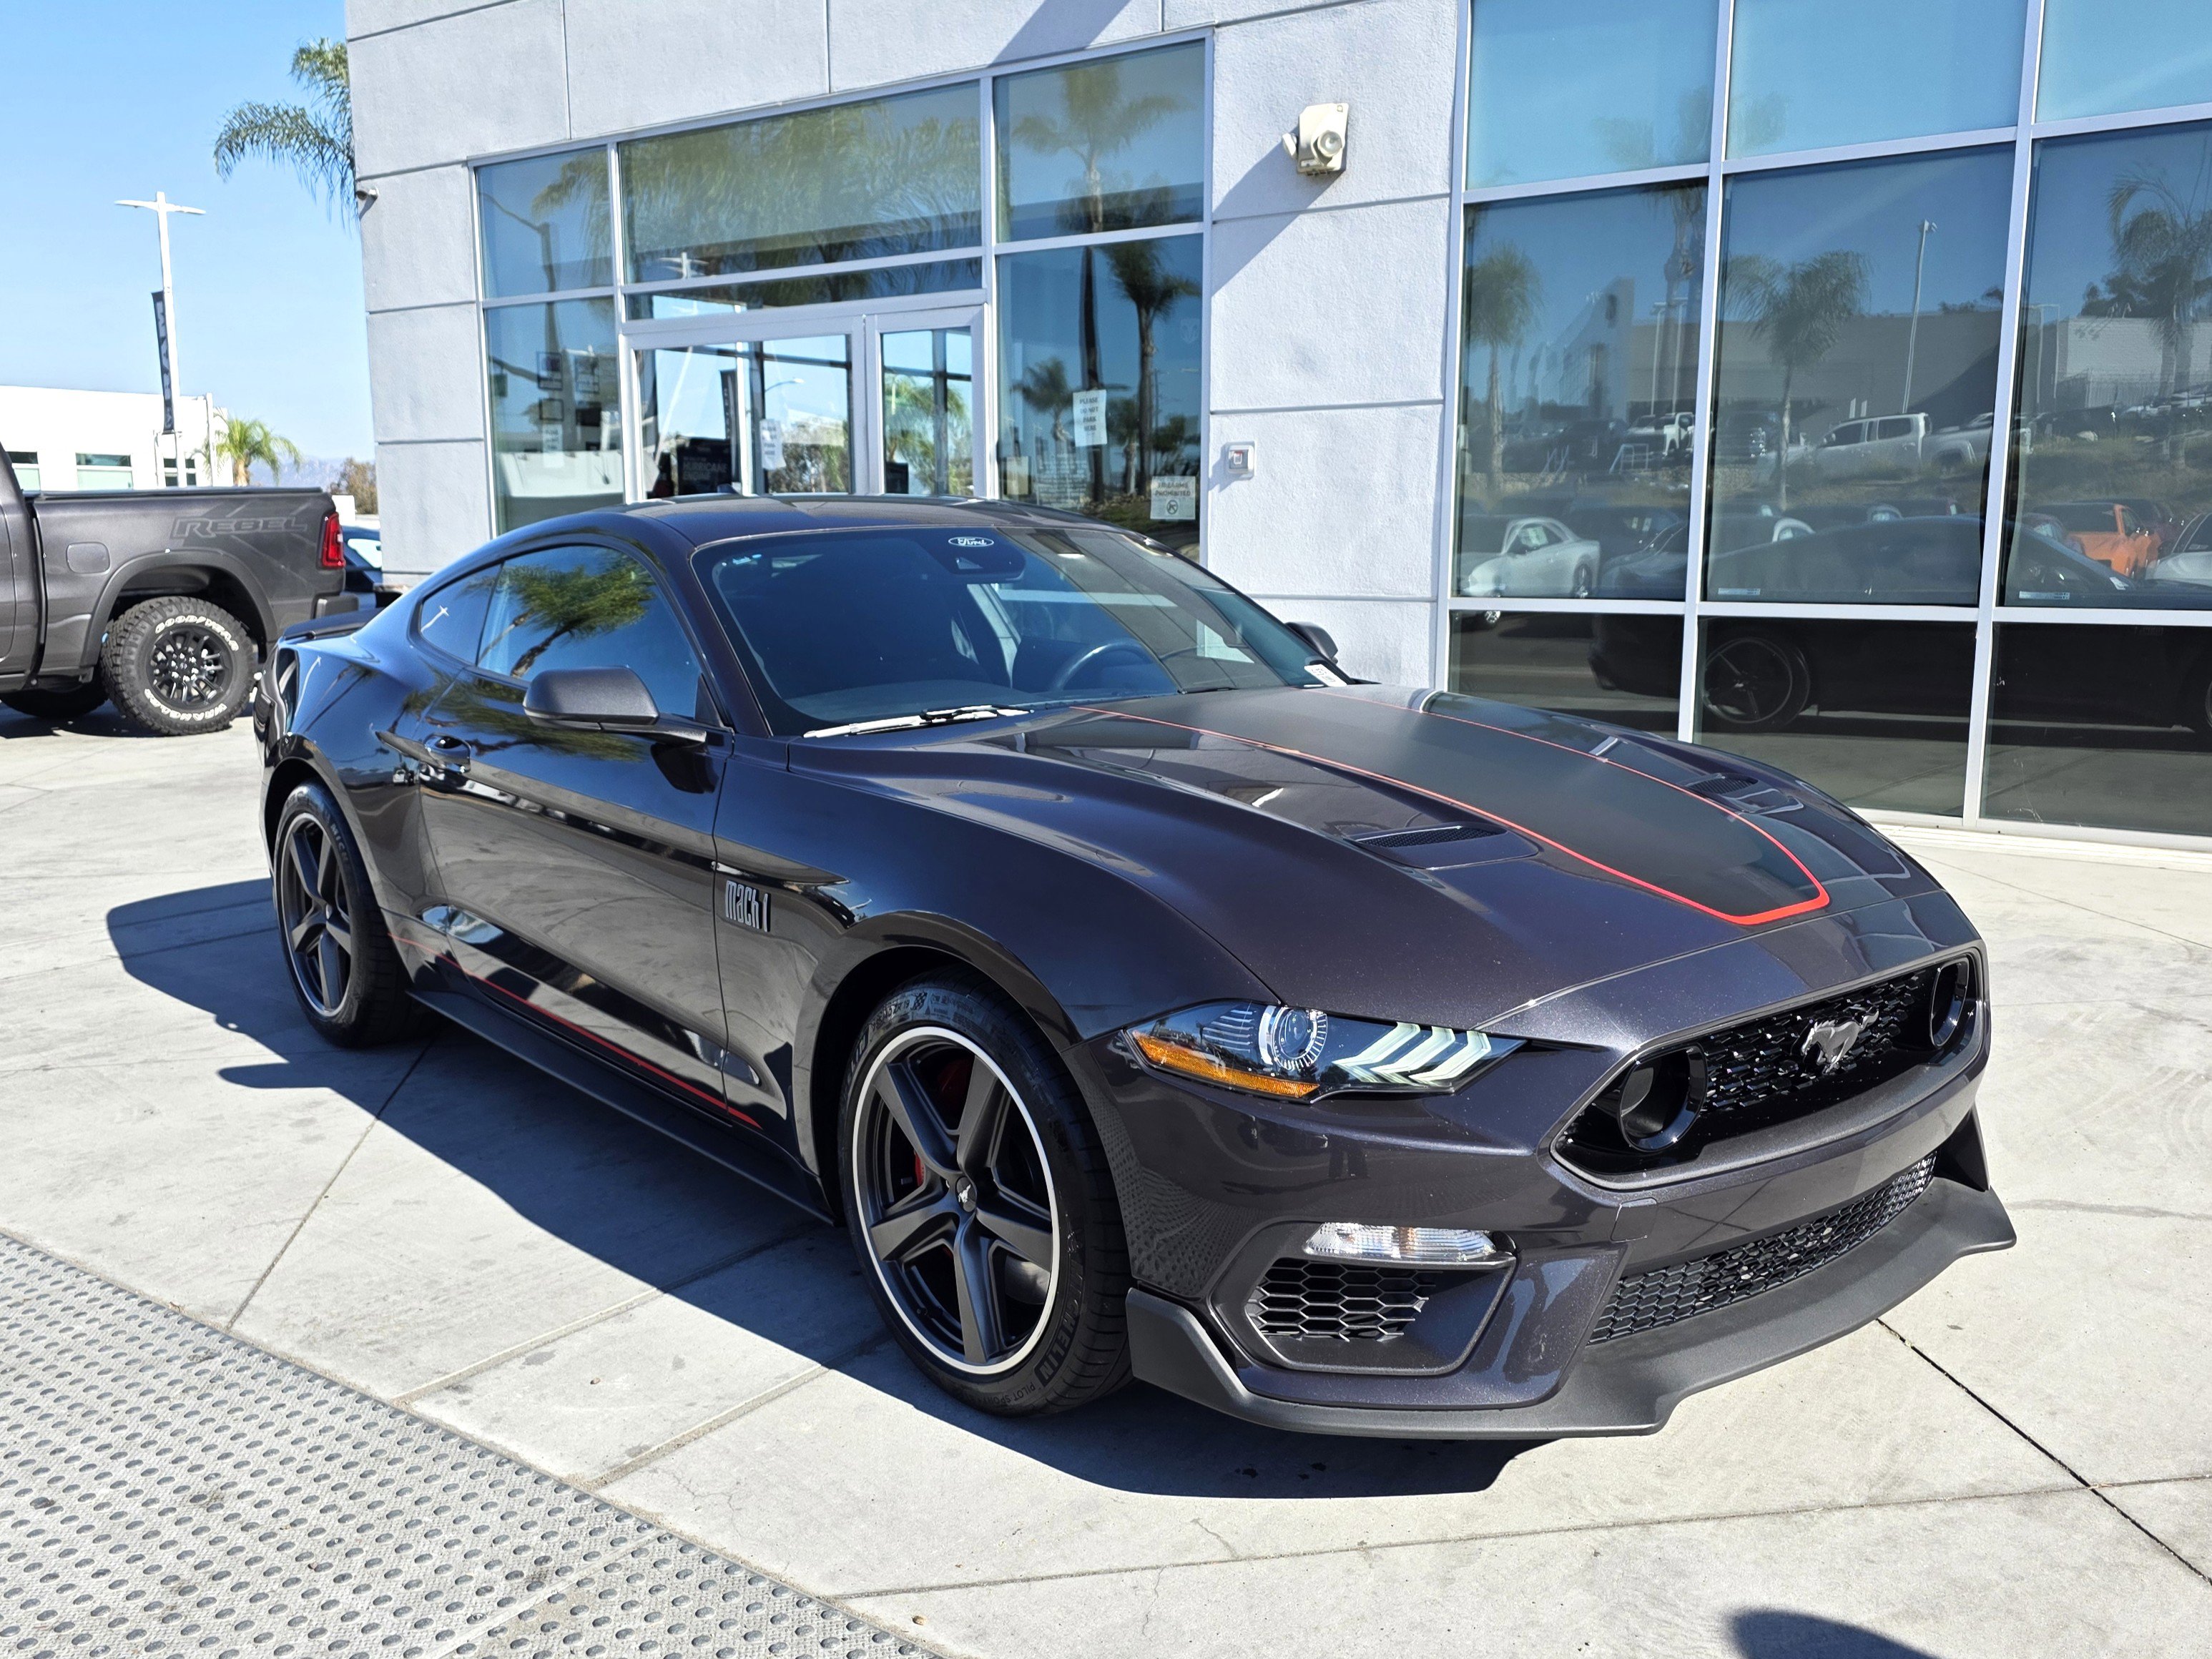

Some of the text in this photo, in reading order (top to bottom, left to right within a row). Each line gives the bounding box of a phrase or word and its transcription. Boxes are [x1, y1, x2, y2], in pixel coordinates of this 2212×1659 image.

[156, 301, 172, 400] RAM
[169, 516, 308, 538] REBEL
[955, 536, 989, 546] Ford
[1013, 1382, 1036, 1402] PILOT
